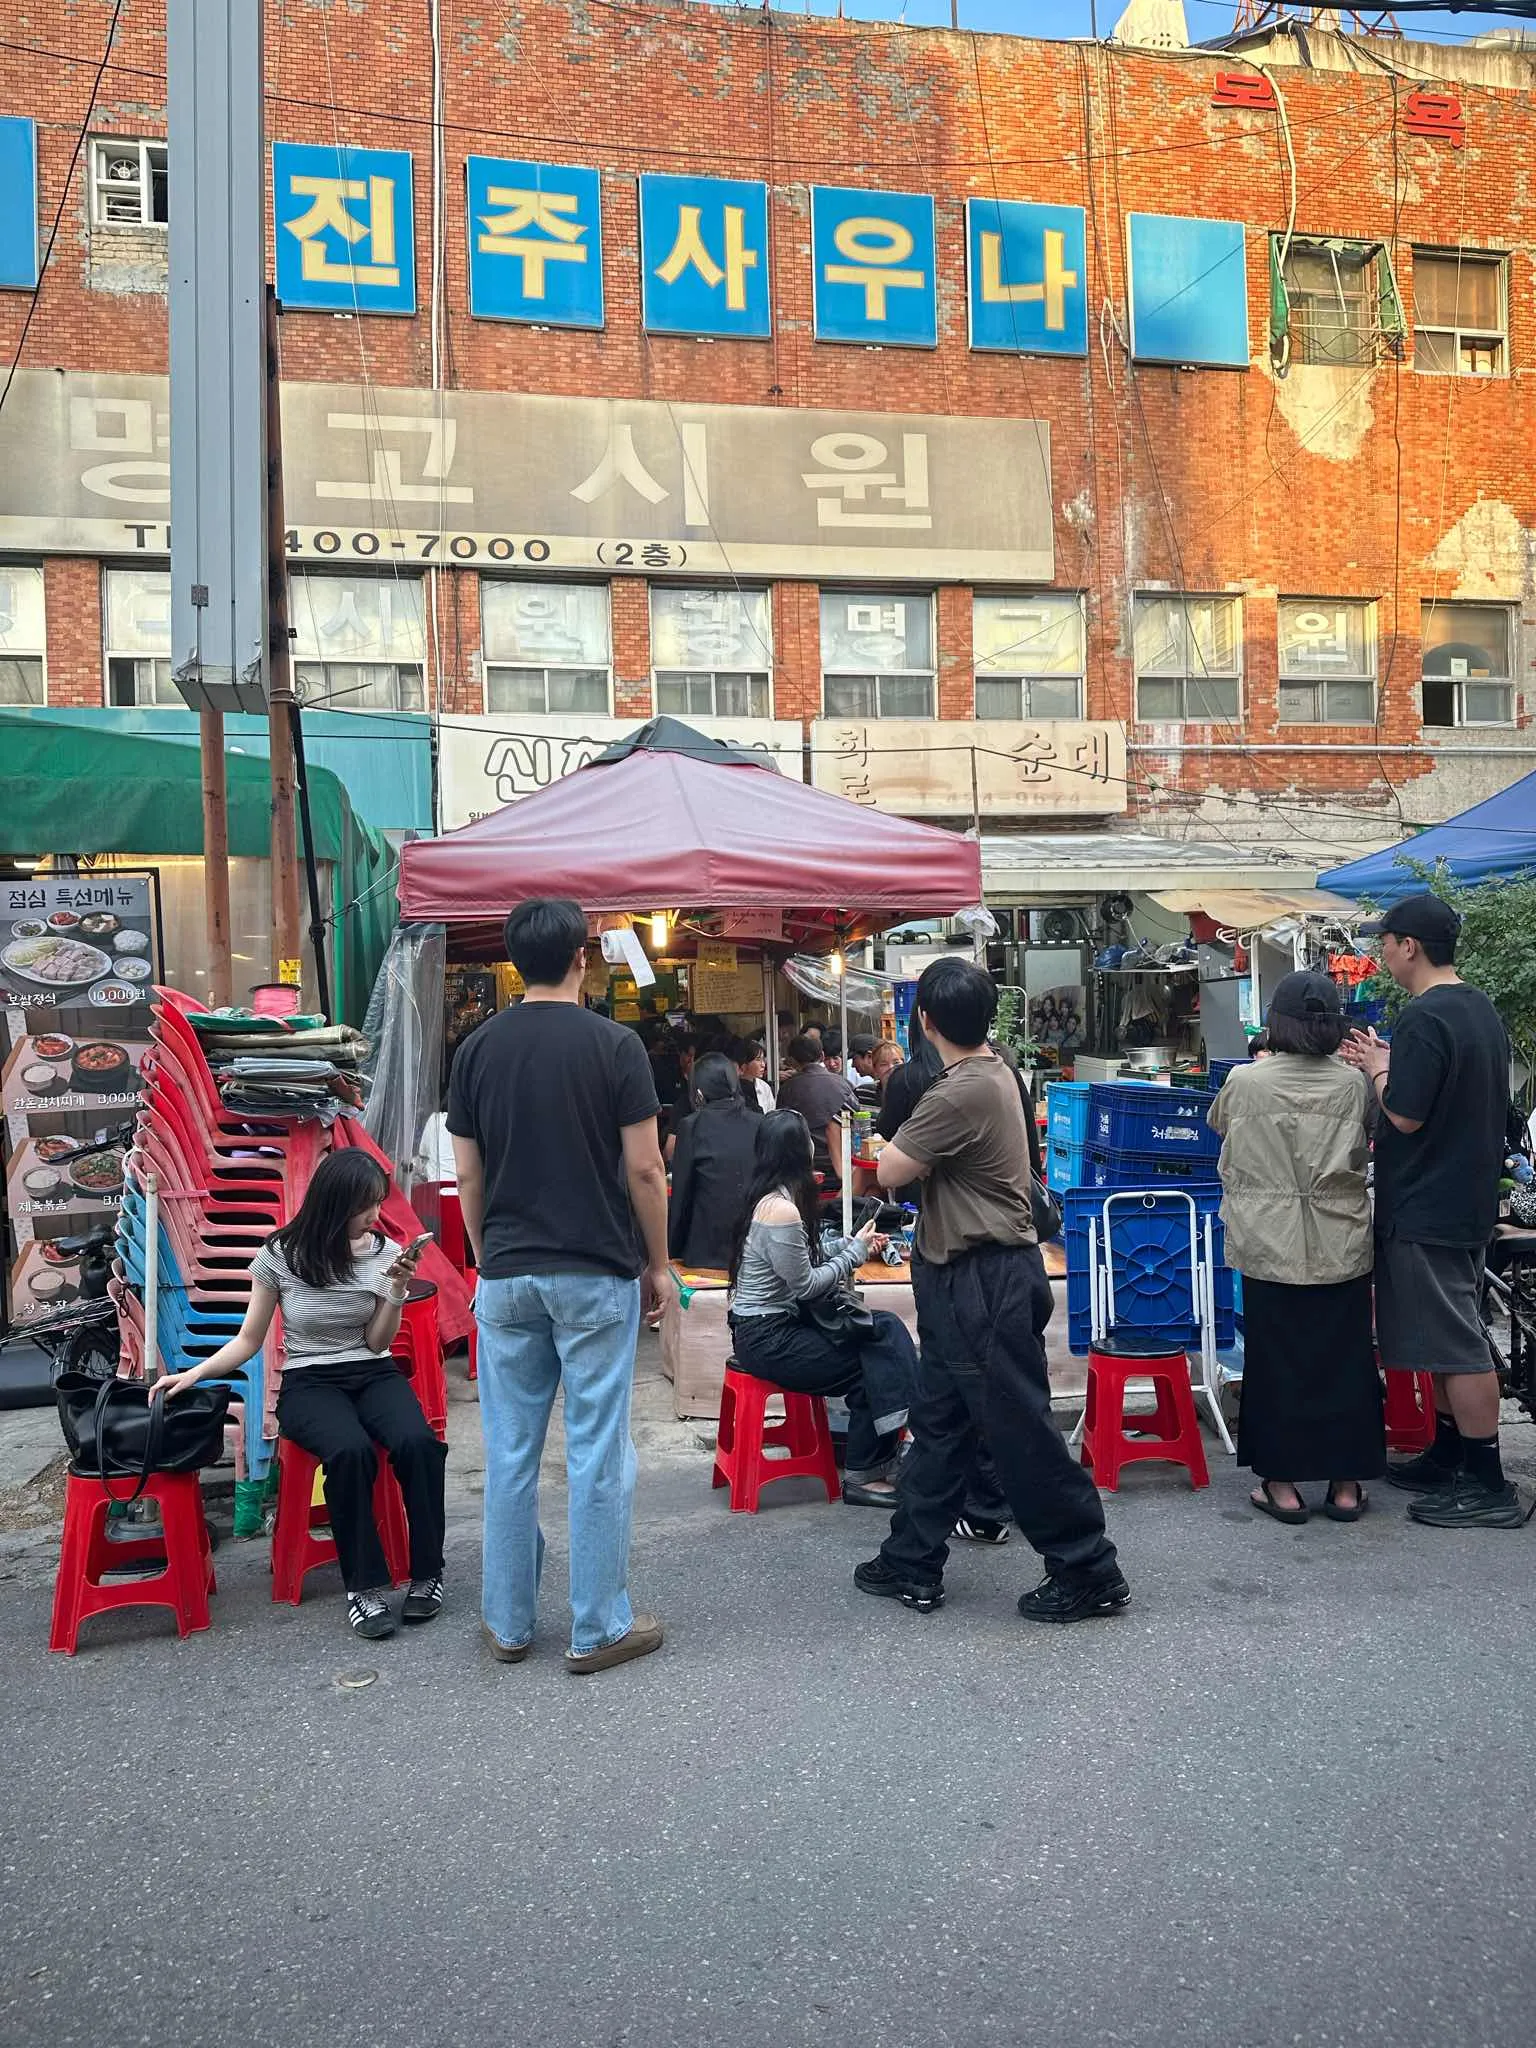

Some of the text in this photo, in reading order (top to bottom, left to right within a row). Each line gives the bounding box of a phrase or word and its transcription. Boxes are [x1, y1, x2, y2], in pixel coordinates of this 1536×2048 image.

[596, 540, 688, 568] (2층)
[1008, 728, 1110, 784] 순대
[8, 886, 134, 909] 점심 특선메뉴
